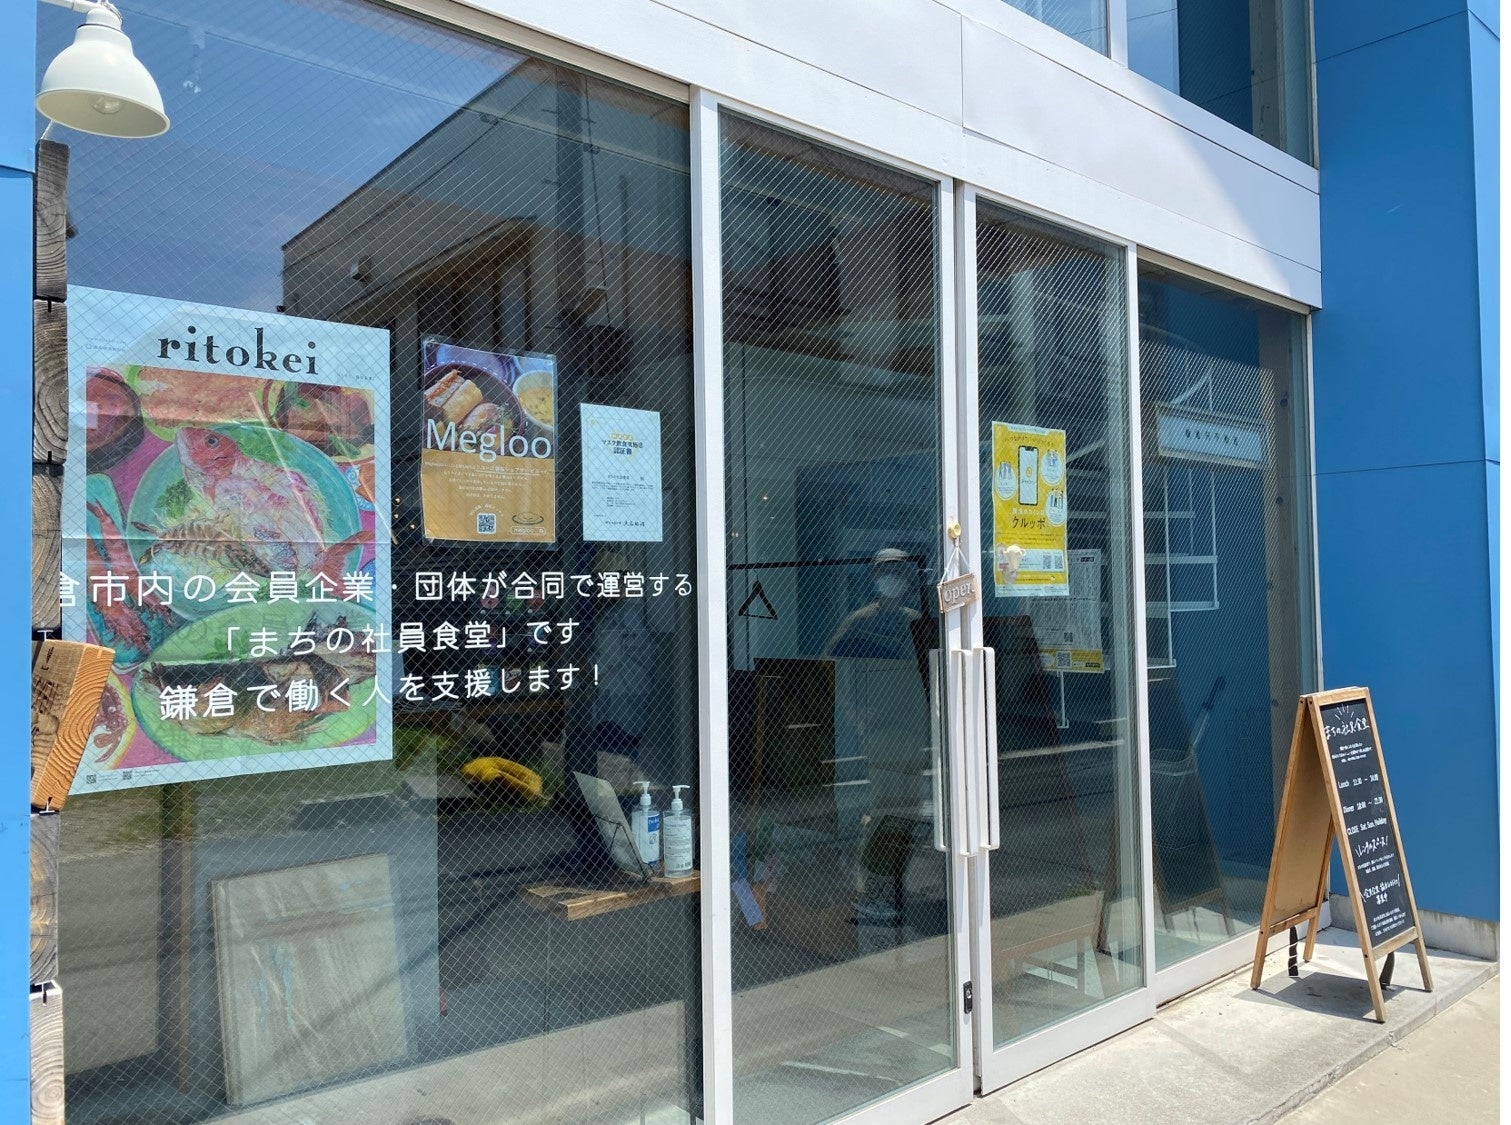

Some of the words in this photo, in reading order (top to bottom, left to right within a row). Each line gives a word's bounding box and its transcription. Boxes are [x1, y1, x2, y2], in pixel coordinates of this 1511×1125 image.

[156, 325, 320, 375] ritokei
[425, 418, 552, 463] Megloo
[226, 617, 581, 657] 「まちの社員食堂」です
